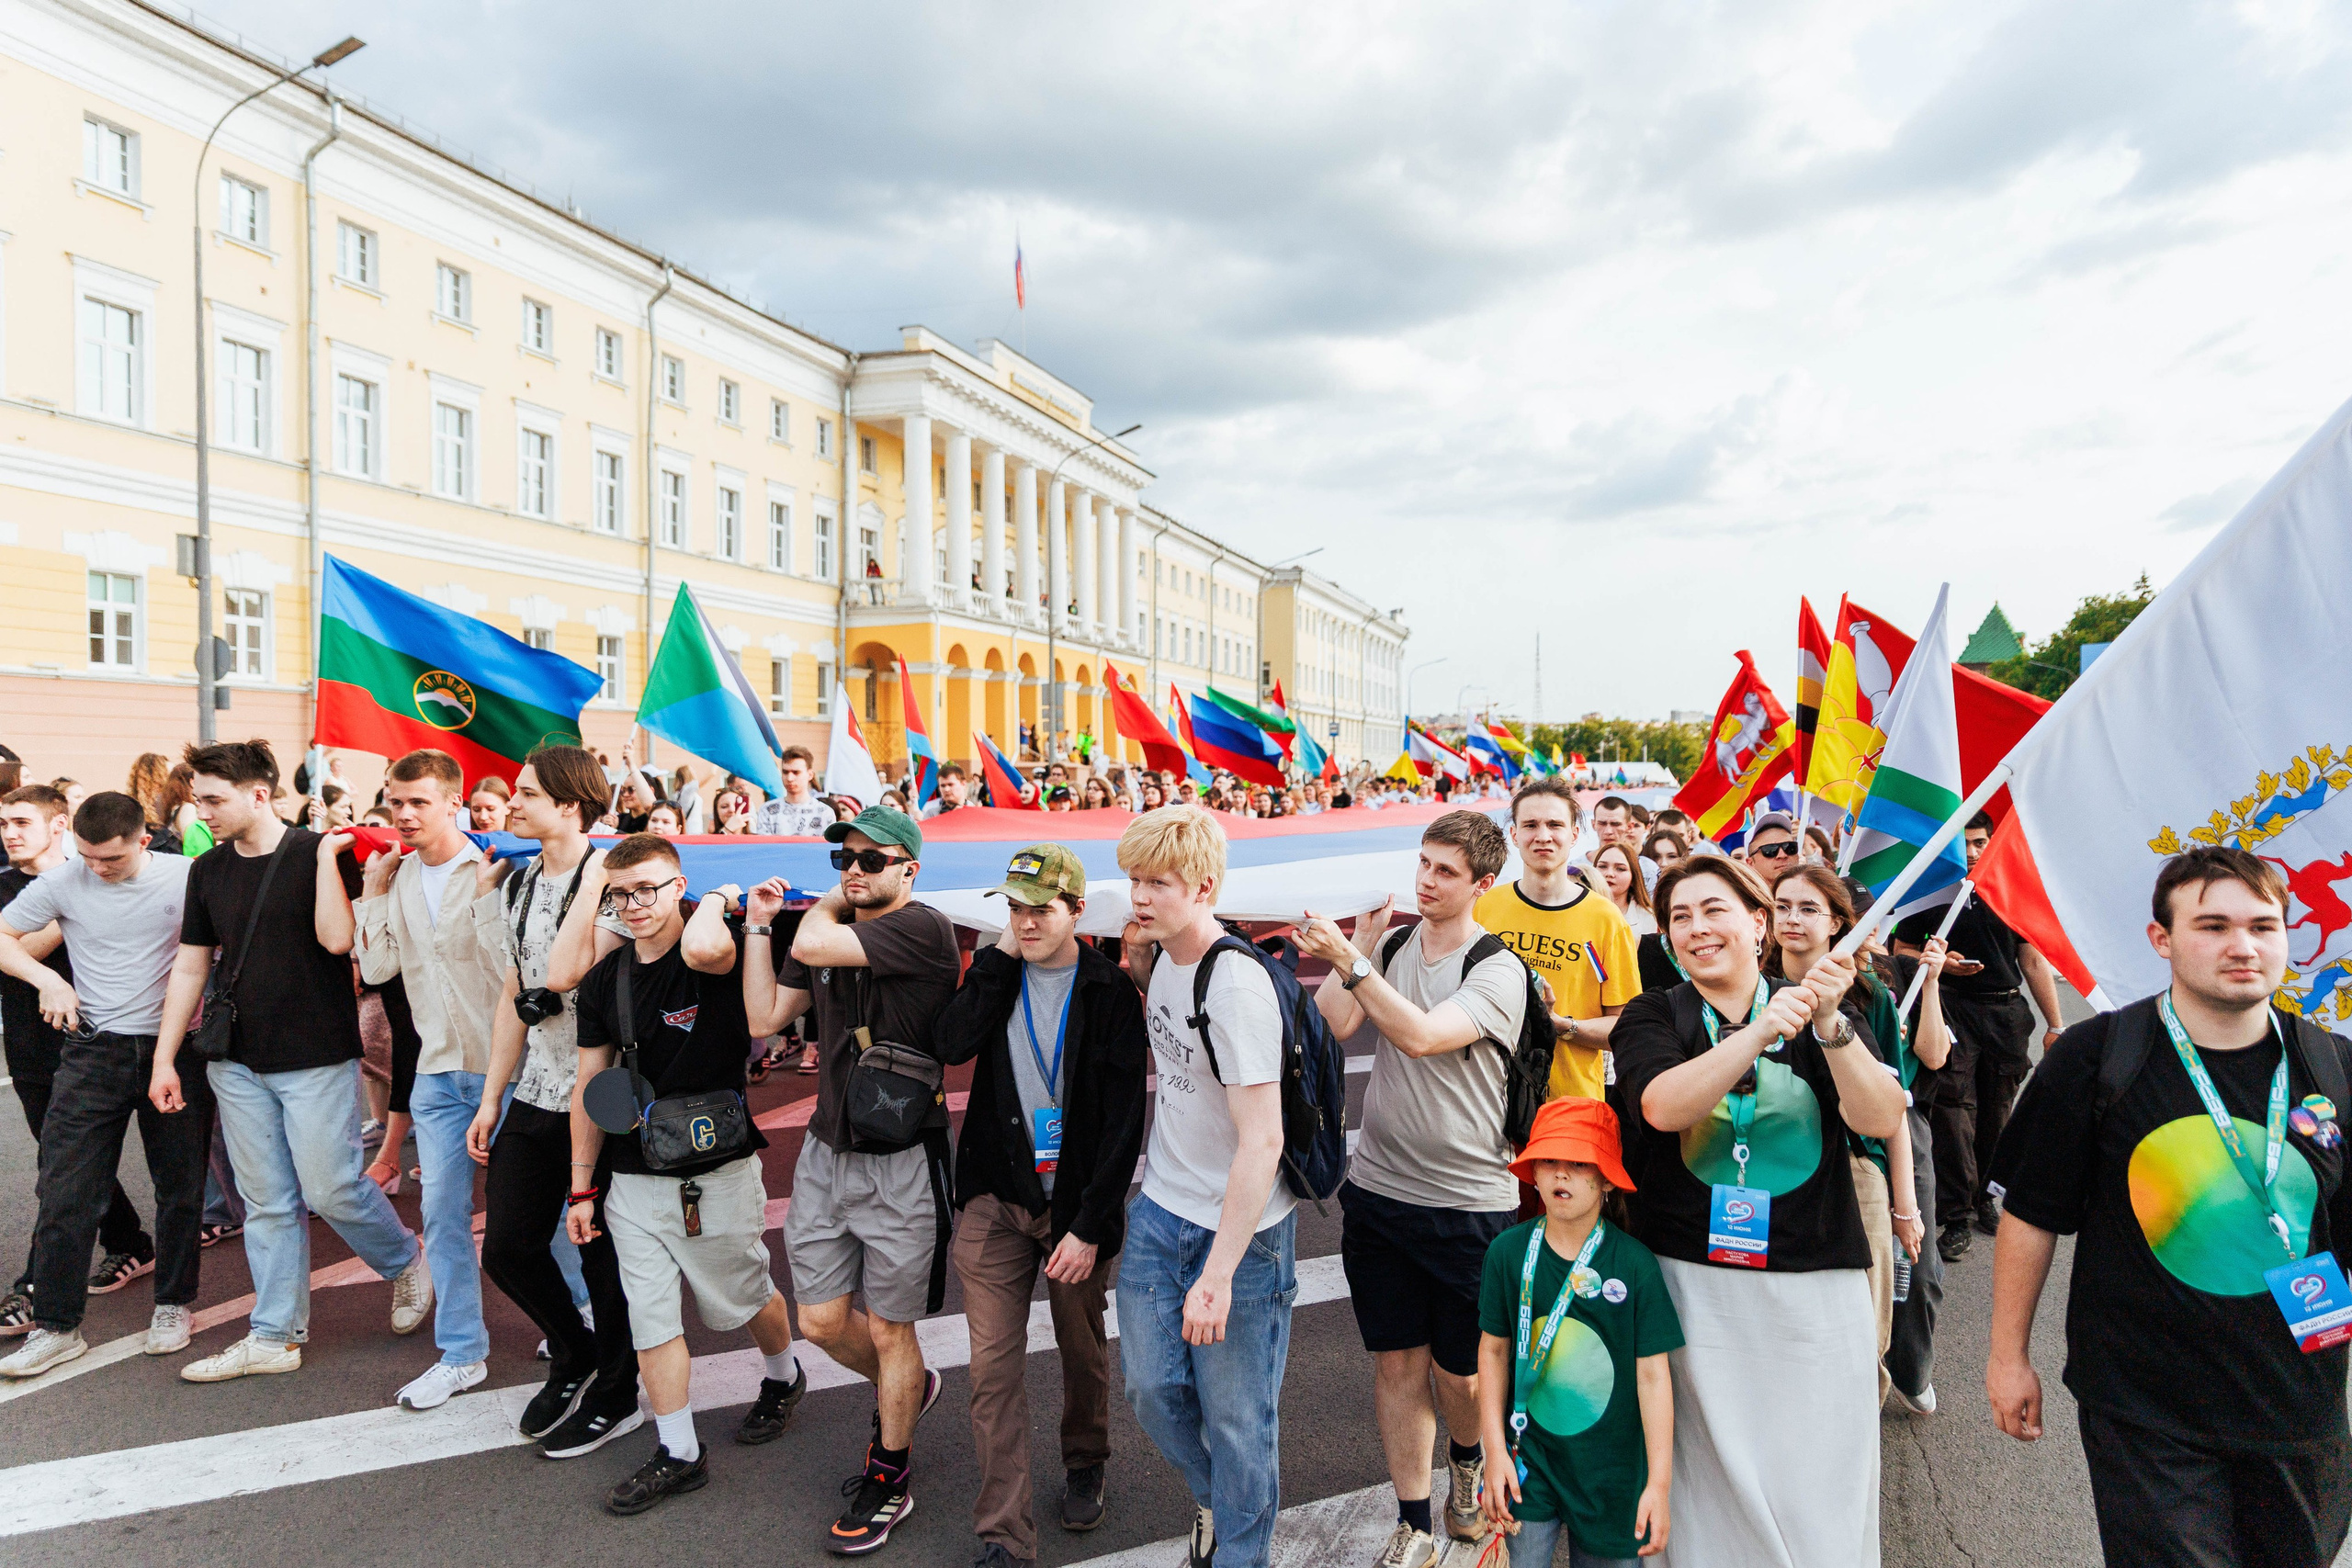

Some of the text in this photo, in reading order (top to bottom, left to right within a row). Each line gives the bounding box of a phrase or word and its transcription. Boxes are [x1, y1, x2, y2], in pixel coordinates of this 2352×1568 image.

[563, 892, 574, 912] Nikon
[1498, 931, 1581, 962] GUESS
[1521, 953, 1562, 971] riginals
[670, 1012, 697, 1023] Car
[1714, 1236, 1762, 1248] ФАДН РОССИИ
[2298, 1320, 2321, 1331] ФАДН
